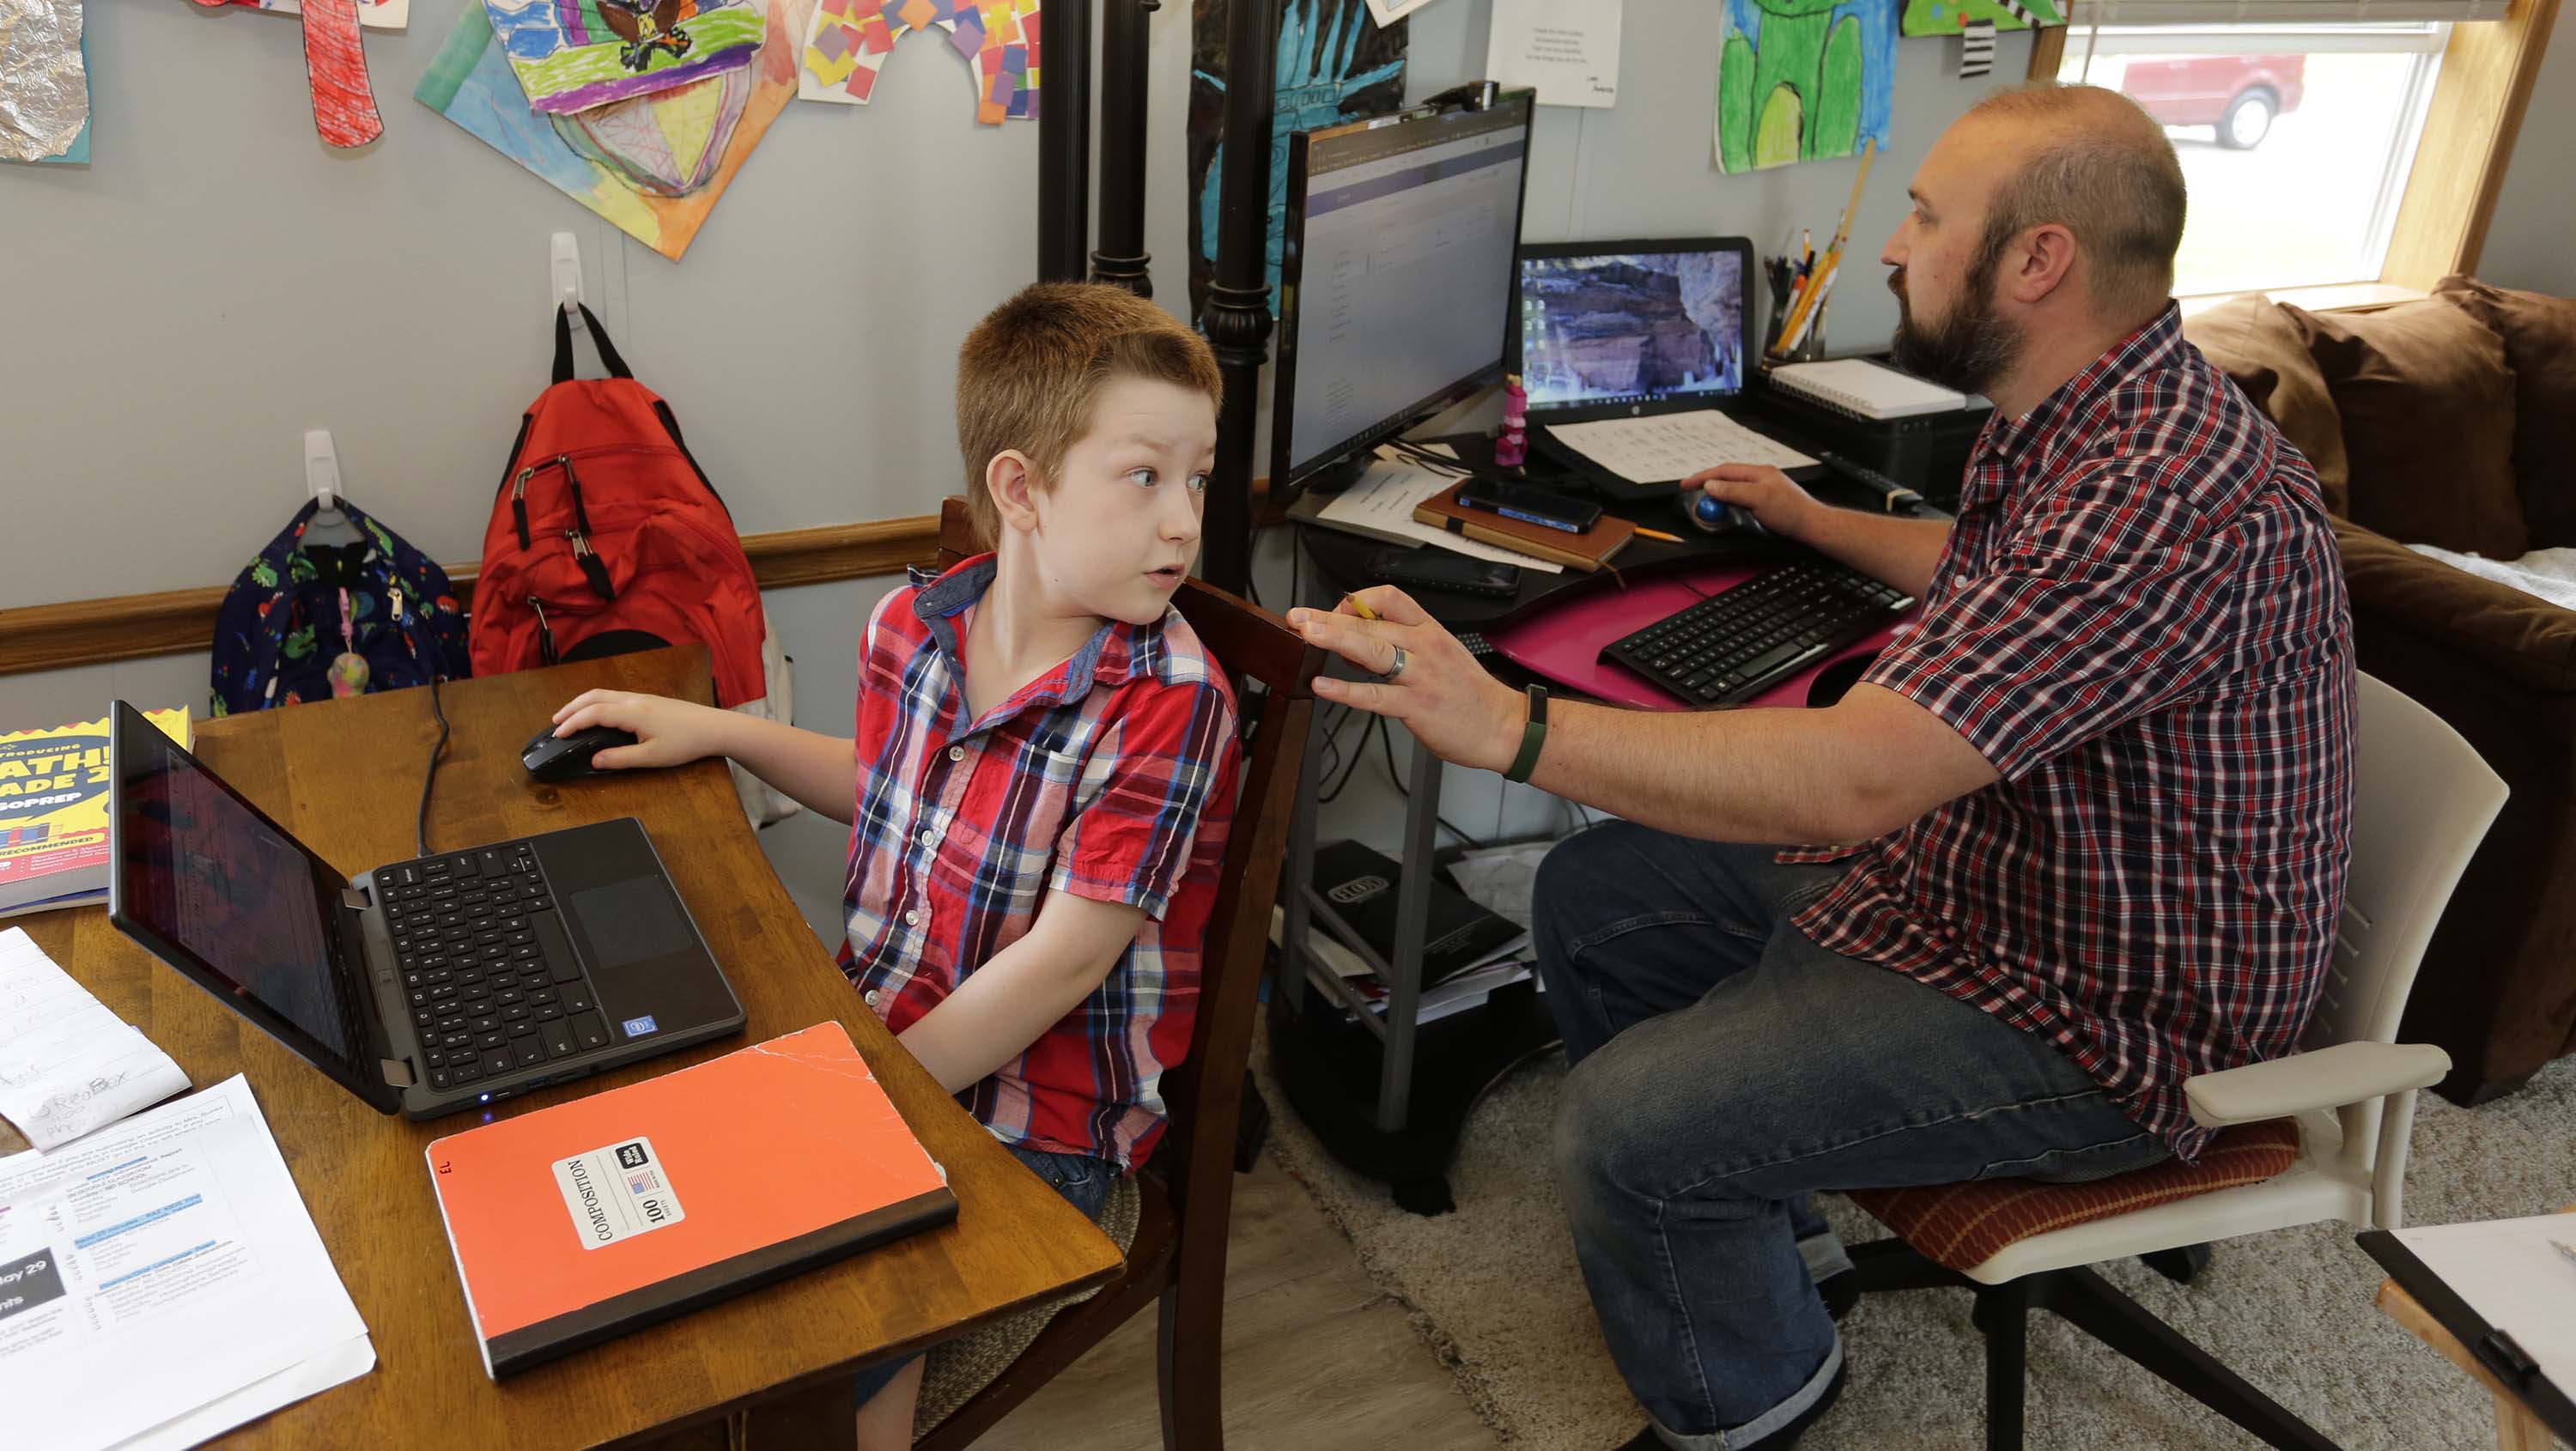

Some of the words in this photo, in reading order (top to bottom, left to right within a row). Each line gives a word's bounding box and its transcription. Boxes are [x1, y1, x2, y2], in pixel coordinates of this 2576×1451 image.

[623, 1149, 635, 1165] Wide
[629, 1145, 644, 1164] Ruled
[568, 1159, 613, 1242] COMPOSITION
[642, 1199, 665, 1223] 100
[25, 1260, 46, 1275] 29
